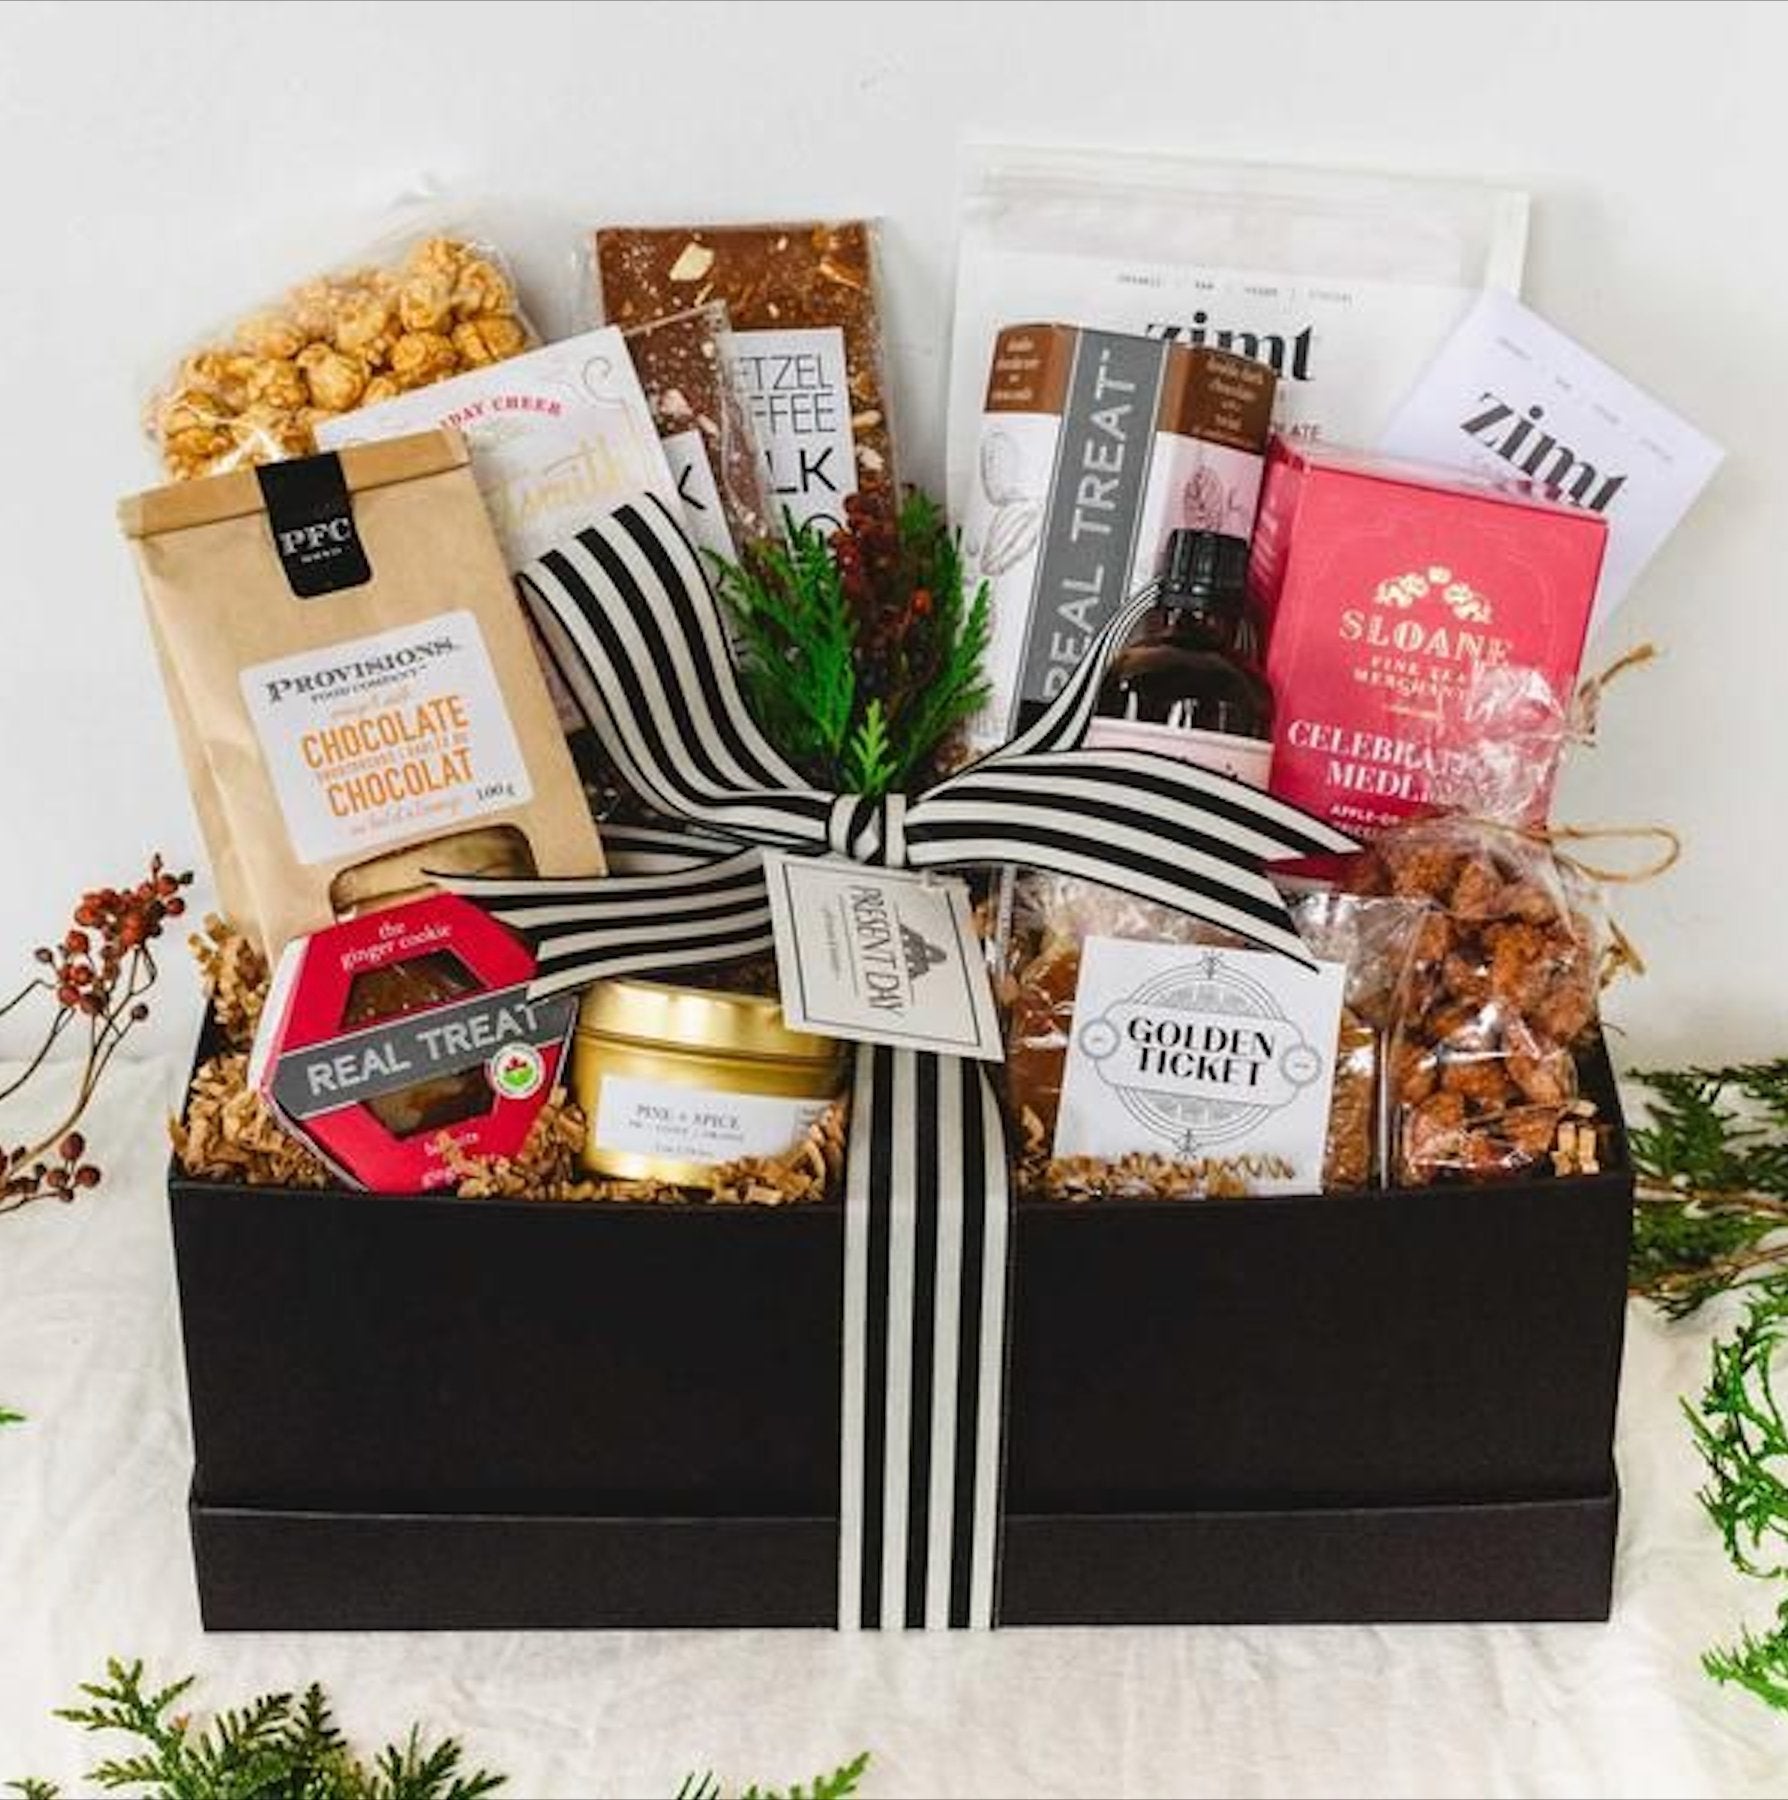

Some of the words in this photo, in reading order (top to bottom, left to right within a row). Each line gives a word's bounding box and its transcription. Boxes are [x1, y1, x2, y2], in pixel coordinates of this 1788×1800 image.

[1071, 364, 1137, 542] TREAT
[279, 517, 350, 556] PFC
[1339, 608, 1513, 668] SLOANE
[264, 637, 455, 703] PROVISIONS
[300, 695, 470, 769] CHOCOLATE
[328, 748, 475, 818] CHOCOLAT
[476, 784, 504, 801] 100
[340, 937, 396, 971] ginger
[399, 924, 453, 950] cookie
[379, 920, 406, 939] the
[305, 1043, 412, 1096] REAL
[415, 1002, 538, 1061] TREAT
[1127, 1015, 1275, 1059] GOLDEN
[1138, 1046, 1267, 1087] TICKET
